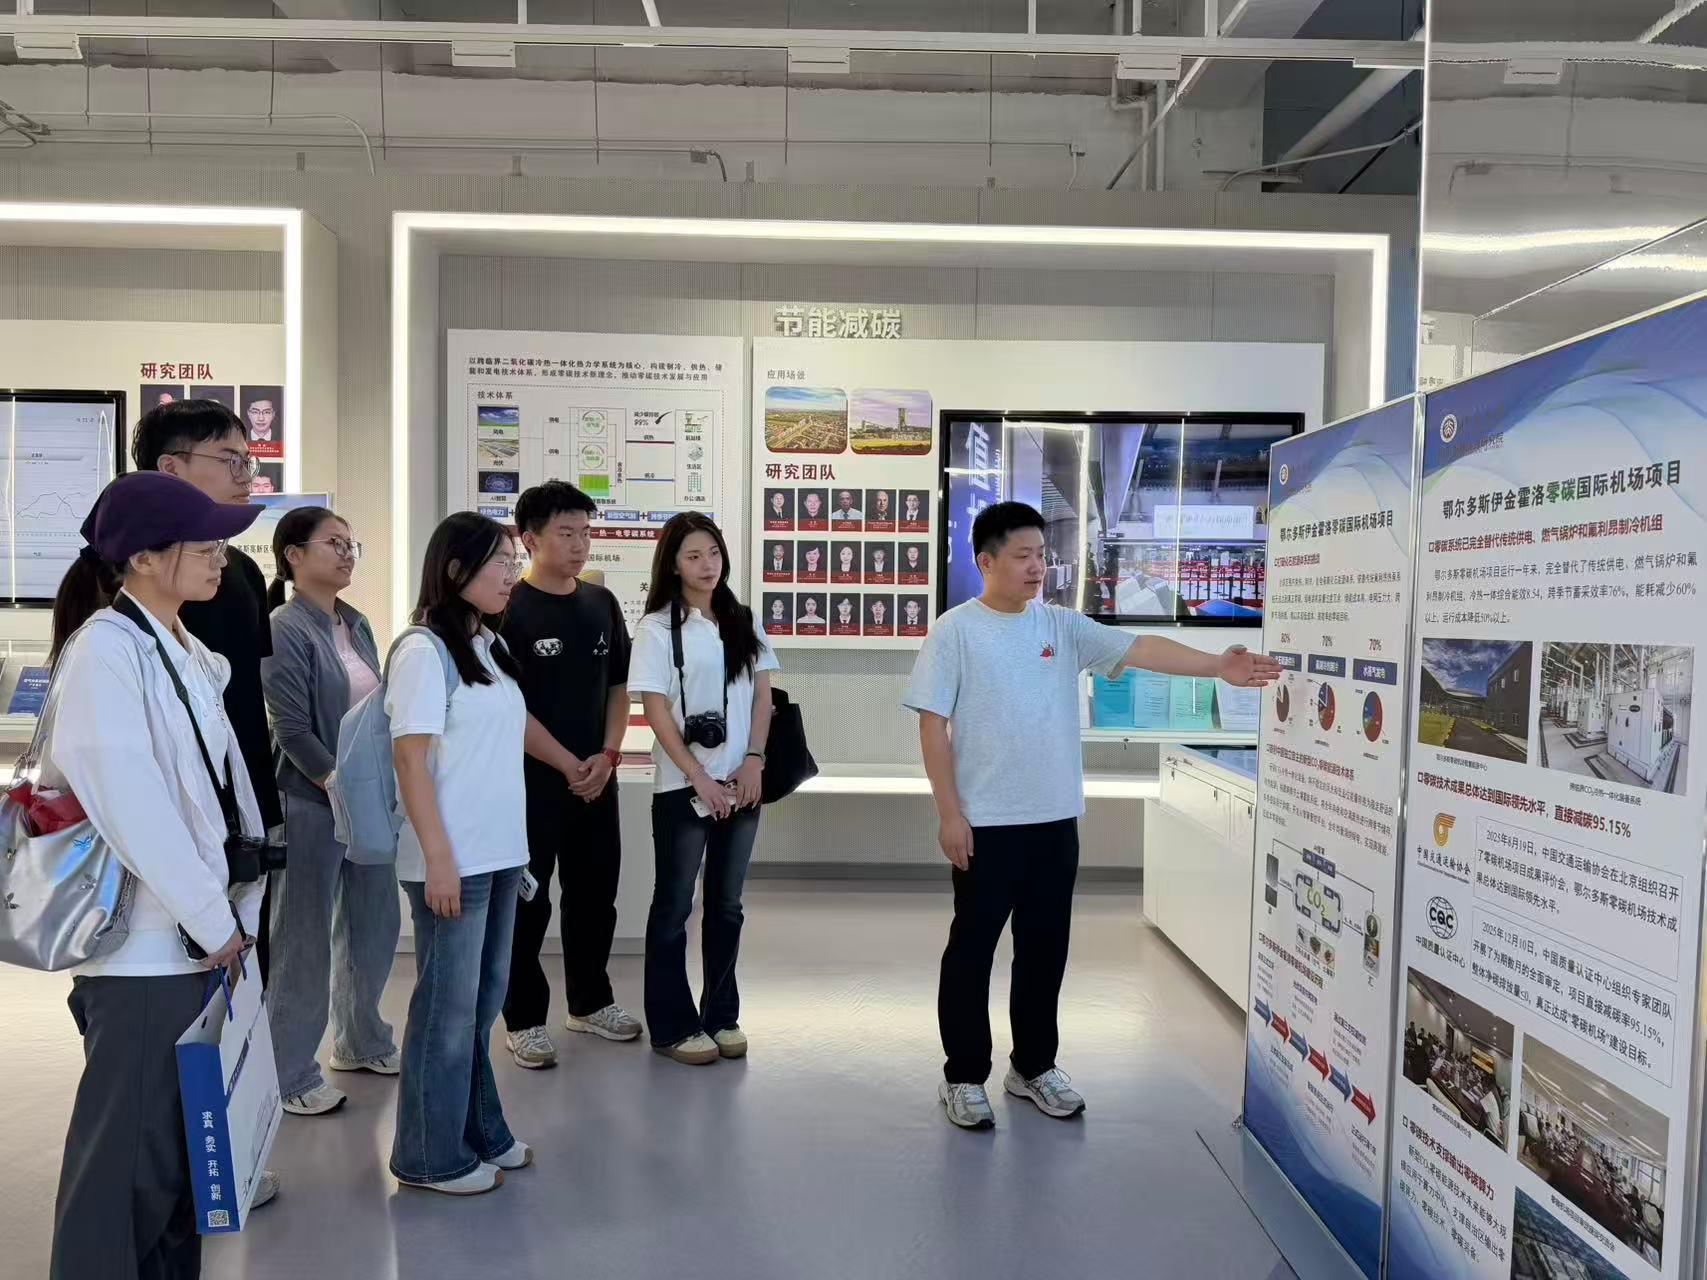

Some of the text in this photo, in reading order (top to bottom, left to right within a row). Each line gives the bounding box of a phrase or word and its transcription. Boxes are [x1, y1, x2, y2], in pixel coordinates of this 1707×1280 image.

[776, 304, 902, 339] 节能减碳
[140, 362, 213, 380] 研究团队
[767, 369, 806, 380] 应用场景
[477, 390, 513, 400] 技术体系
[765, 463, 836, 480] 研究团队
[1442, 459, 1681, 519] 鄂尔多斯伊金霍洛零碳国际机场项目
[1429, 905, 1454, 930] CQC
[1415, 935, 1466, 968] 中国质量认证中心
[210, 1183, 222, 1201] 创新
